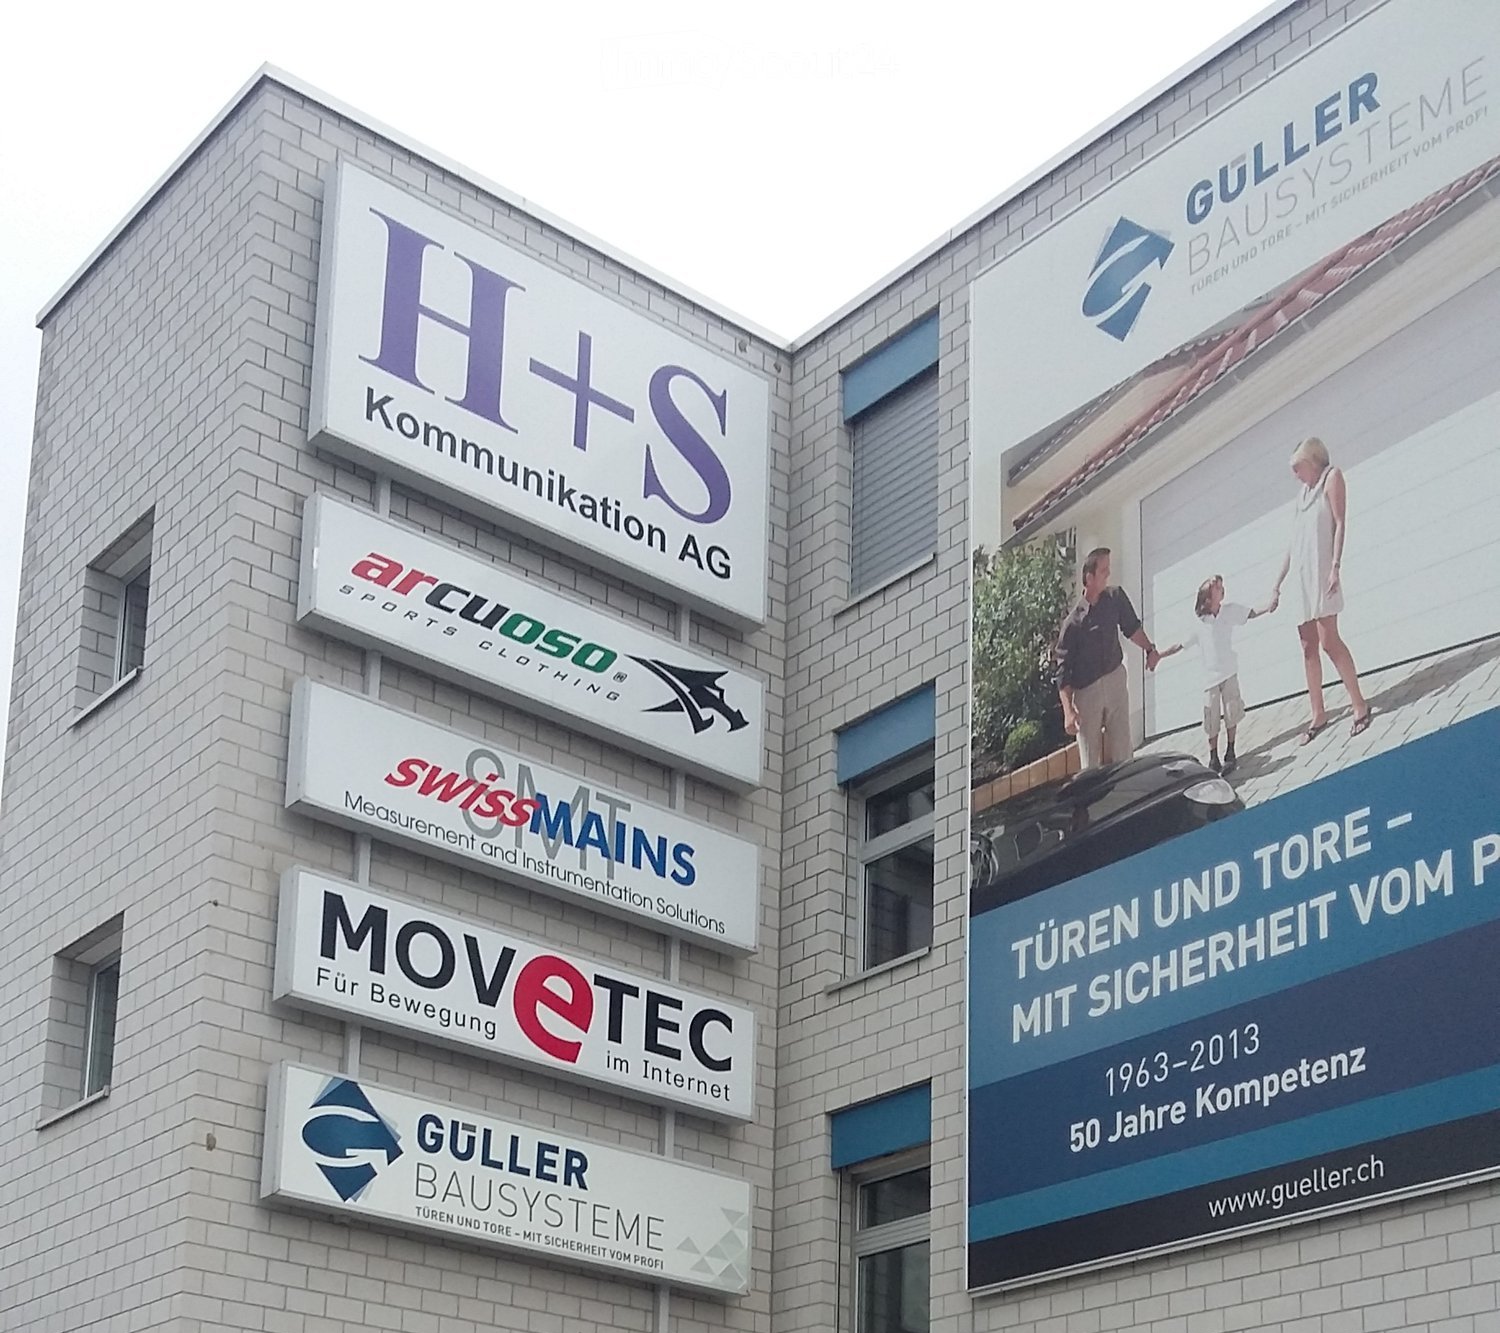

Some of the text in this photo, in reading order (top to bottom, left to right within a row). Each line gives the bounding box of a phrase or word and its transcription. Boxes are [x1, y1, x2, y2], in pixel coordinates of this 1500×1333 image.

[1186, 71, 1381, 225] GÜLLER
[1188, 55, 1487, 276] BAUSYSTEME
[1191, 264, 1229, 295] TÜREN
[1232, 243, 1257, 268] UND
[1261, 225, 1292, 252] TORE
[1305, 203, 1328, 225] MIT
[1331, 153, 1409, 210] SICHERHEIT
[1413, 136, 1442, 157] VOM
[1445, 106, 1487, 140] PROFI
[358, 206, 732, 524] H+S
[366, 386, 731, 580] Kommunikation AG
[339, 585, 620, 701] SPORTS CLOTHING
[345, 791, 725, 934] Measurement and Instrumentation Solutions
[1011, 898, 1139, 979] TÜREN
[1153, 861, 1240, 928] UND
[1254, 806, 1371, 890] TORE
[1011, 984, 1077, 1042] MIT
[1088, 892, 1336, 1020] SICHERHEIT
[1349, 849, 1453, 925] VOM
[317, 968, 730, 1101] Für Bewegung im Internet
[1069, 1045, 1366, 1153] 50 Jahre Kompetenz
[415, 1162, 665, 1252] BAUSYSTEME
[417, 1114, 589, 1190] GÜLLER
[1208, 1154, 1384, 1218] www.gueller.ch
[415, 1206, 454, 1225] TÜREN
[457, 1215, 481, 1230] UND
[484, 1221, 512, 1237] TORE
[523, 1230, 541, 1244] MIT
[544, 1235, 607, 1258] SICHERHEIT
[609, 1250, 631, 1264] VOM
[634, 1255, 664, 1270] PROFI
